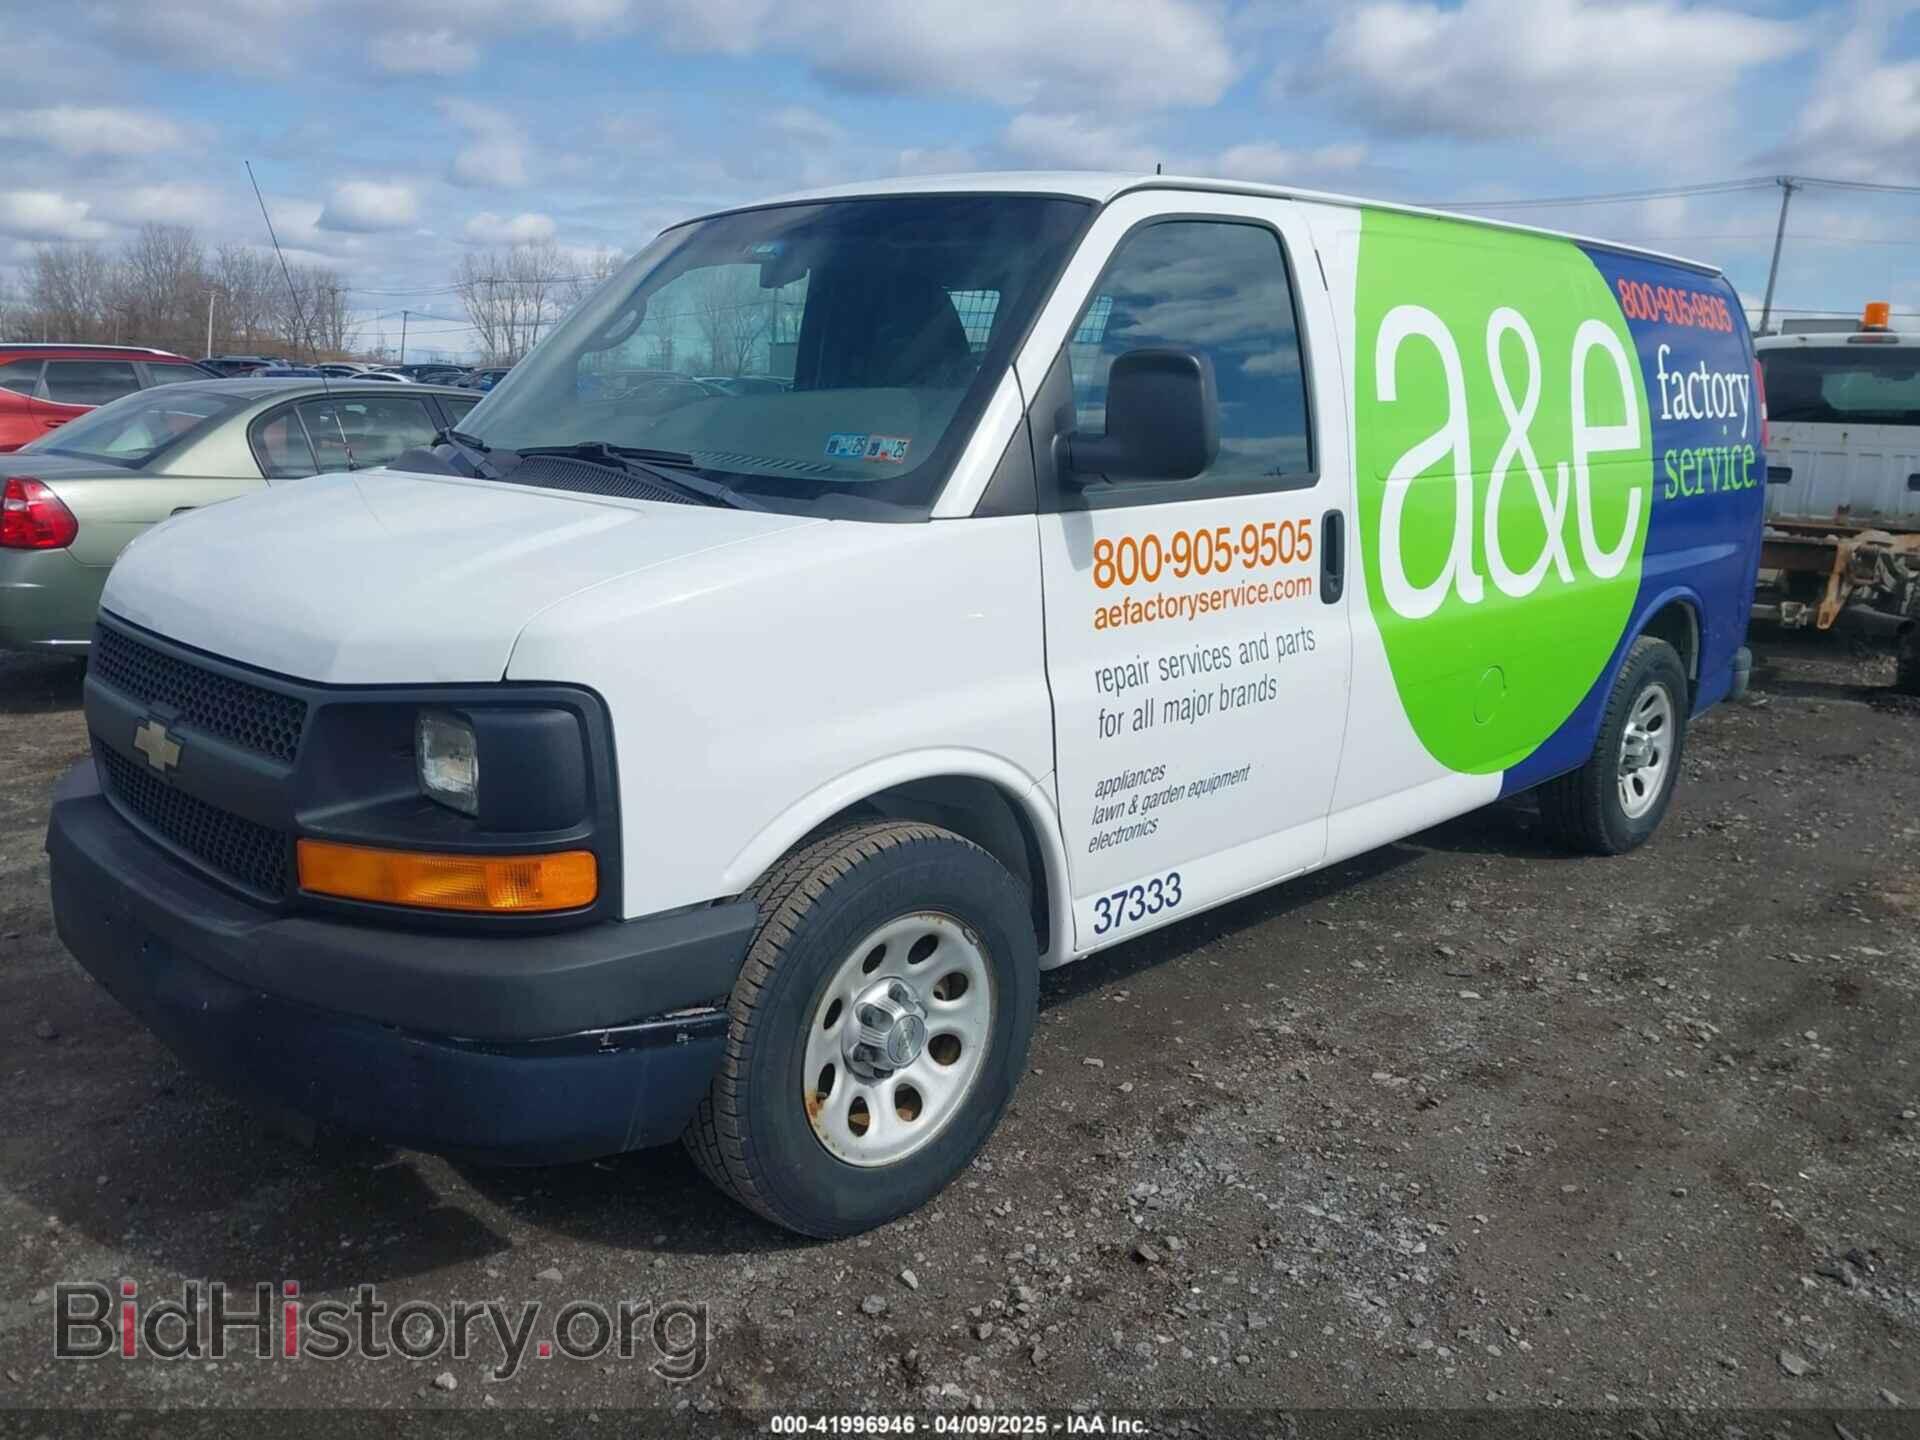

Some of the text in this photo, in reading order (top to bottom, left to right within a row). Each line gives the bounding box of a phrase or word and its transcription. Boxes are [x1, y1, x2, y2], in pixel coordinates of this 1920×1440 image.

[1657, 344, 1749, 438] factory
[1376, 305, 1642, 619] a&e
[1094, 576, 1312, 631] aefactoryservice.com
[1095, 626, 1316, 697] repair services and parts
[1098, 673, 1277, 739] for all major brands
[1092, 763, 1251, 826] lawn & garden equipment
[1095, 763, 1166, 800] appliances
[1088, 816, 1159, 853] electronics
[1094, 872, 1182, 934] 37333
